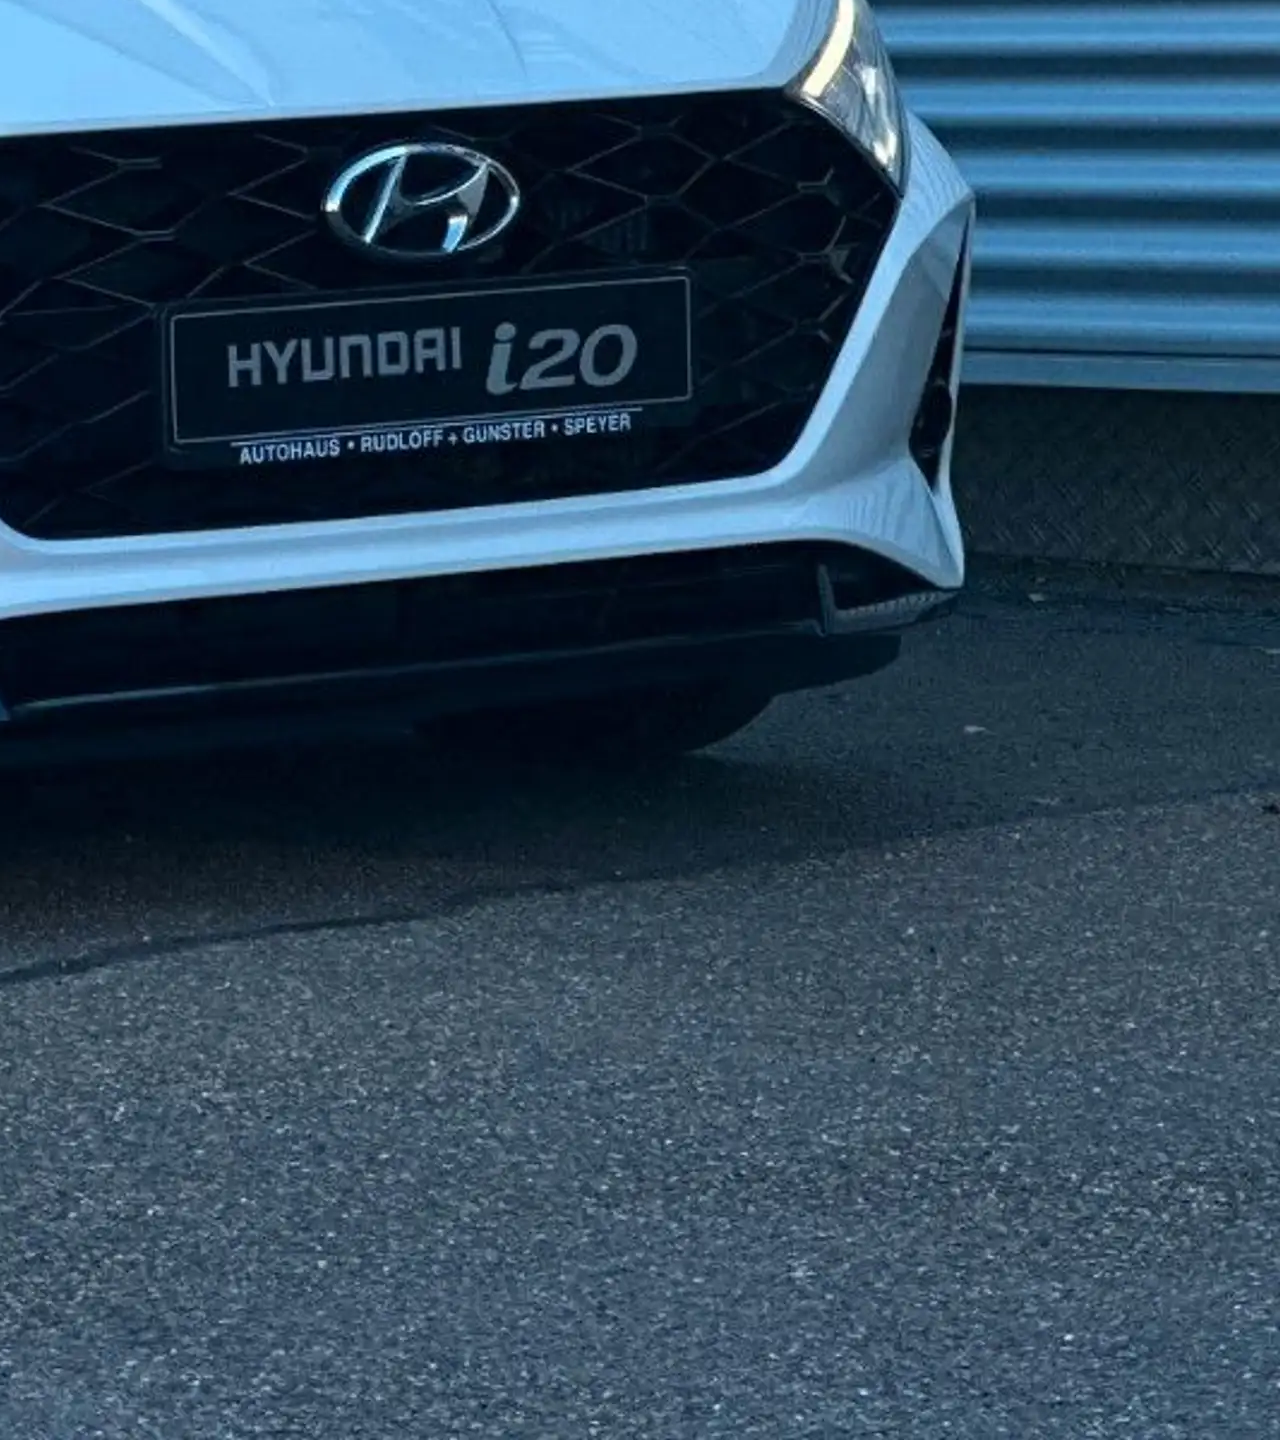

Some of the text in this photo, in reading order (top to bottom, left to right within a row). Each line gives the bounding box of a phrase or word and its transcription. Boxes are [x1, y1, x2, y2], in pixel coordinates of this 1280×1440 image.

[227, 321, 639, 396] HYUNDAI i20
[240, 438, 340, 465] AUTOHAUS
[360, 427, 444, 453] RUDLOFF
[564, 412, 632, 436] SPEYER
